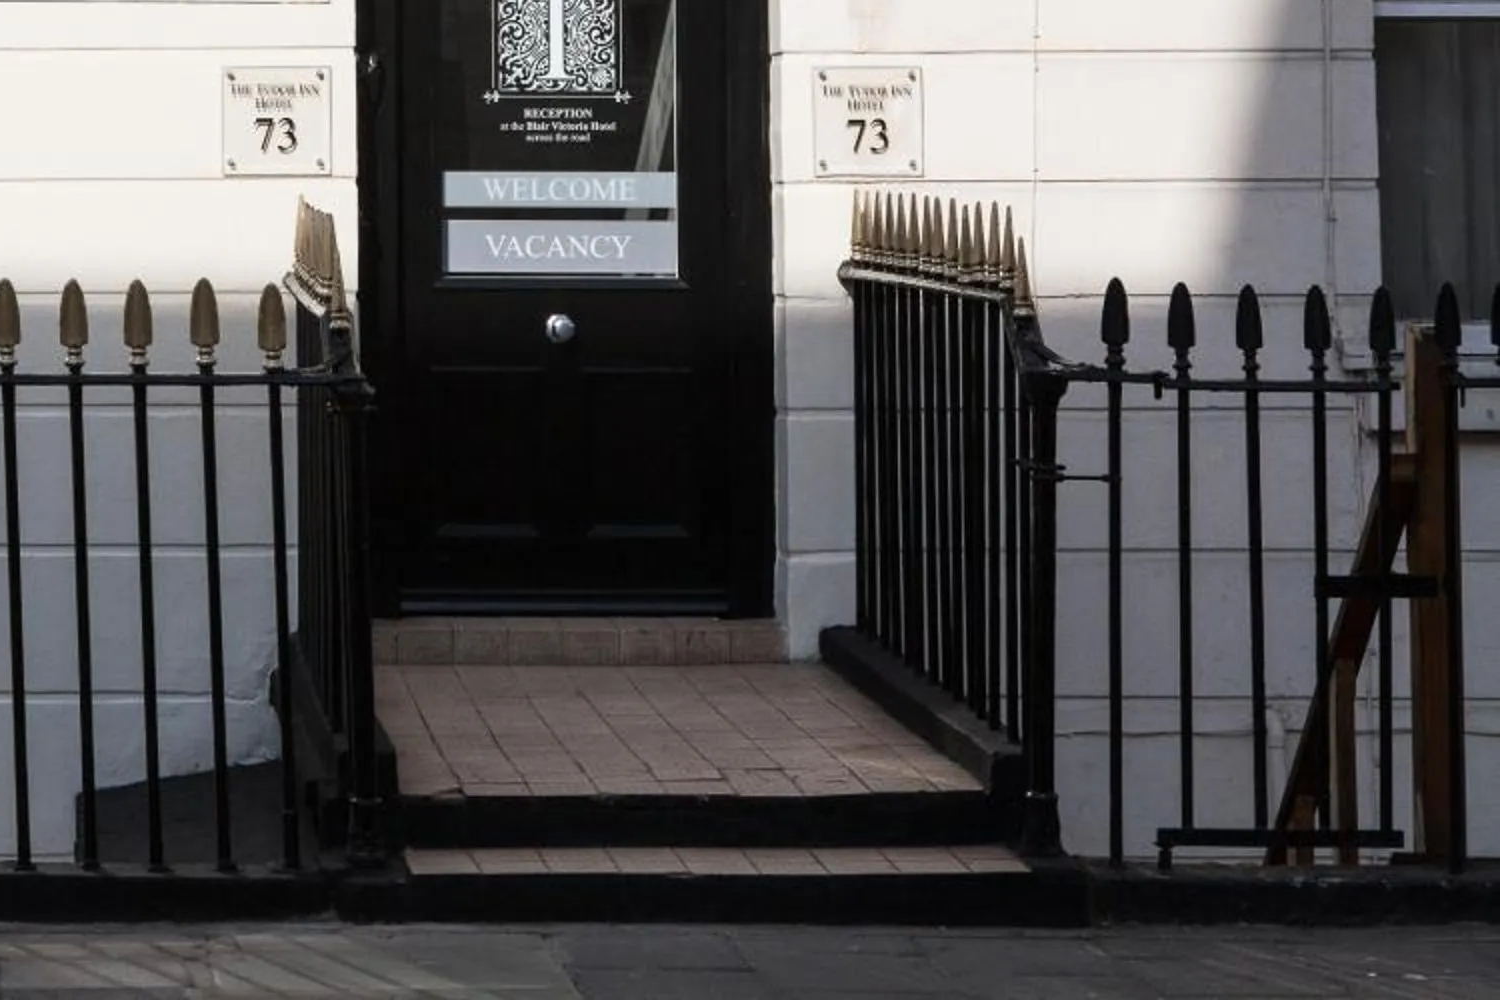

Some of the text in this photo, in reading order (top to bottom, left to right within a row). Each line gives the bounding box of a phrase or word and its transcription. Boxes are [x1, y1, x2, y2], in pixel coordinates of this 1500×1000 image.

[523, 107, 593, 119] RECEPTION
[254, 117, 298, 154] 73
[846, 118, 889, 154] 73
[482, 177, 637, 201] WELCOME
[485, 234, 632, 259] VACANCY
